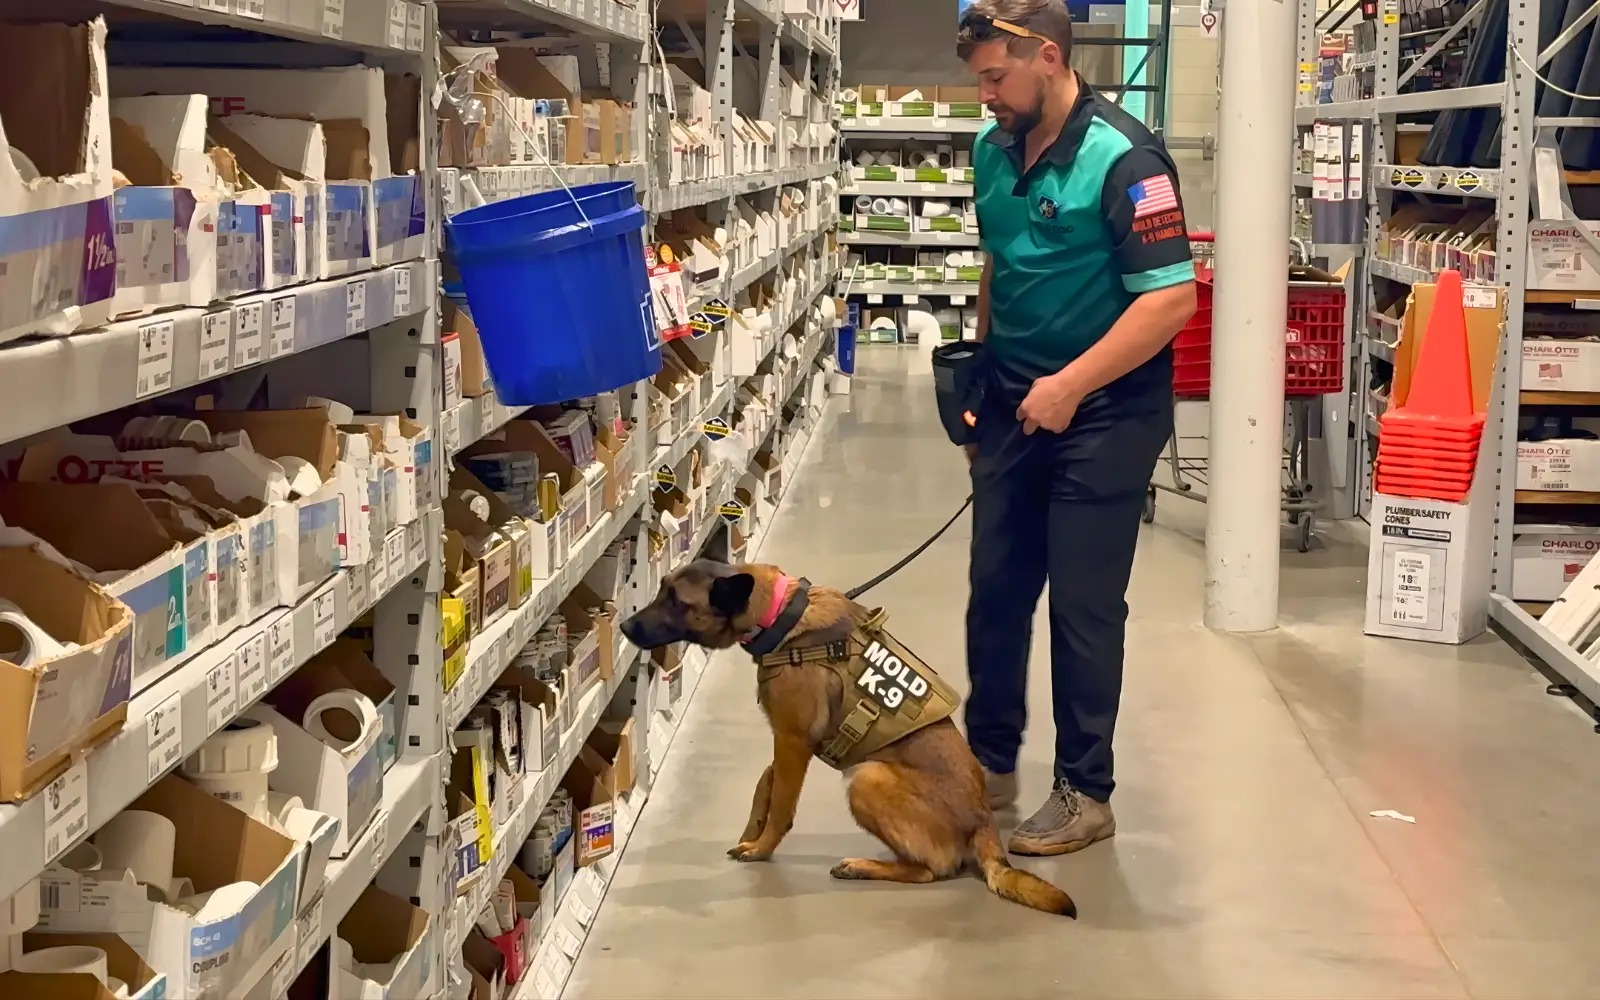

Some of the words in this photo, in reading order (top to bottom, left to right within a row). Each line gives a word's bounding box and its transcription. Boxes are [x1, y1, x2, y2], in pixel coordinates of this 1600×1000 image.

[1523, 346, 1580, 354] CHARLOTTE
[1516, 447, 1571, 455] CHARLOTTE
[1422, 509, 1451, 520] SAFETY
[1385, 515, 1411, 525] CONES
[864, 641, 927, 696] MOLD
[857, 667, 903, 708] K-9
